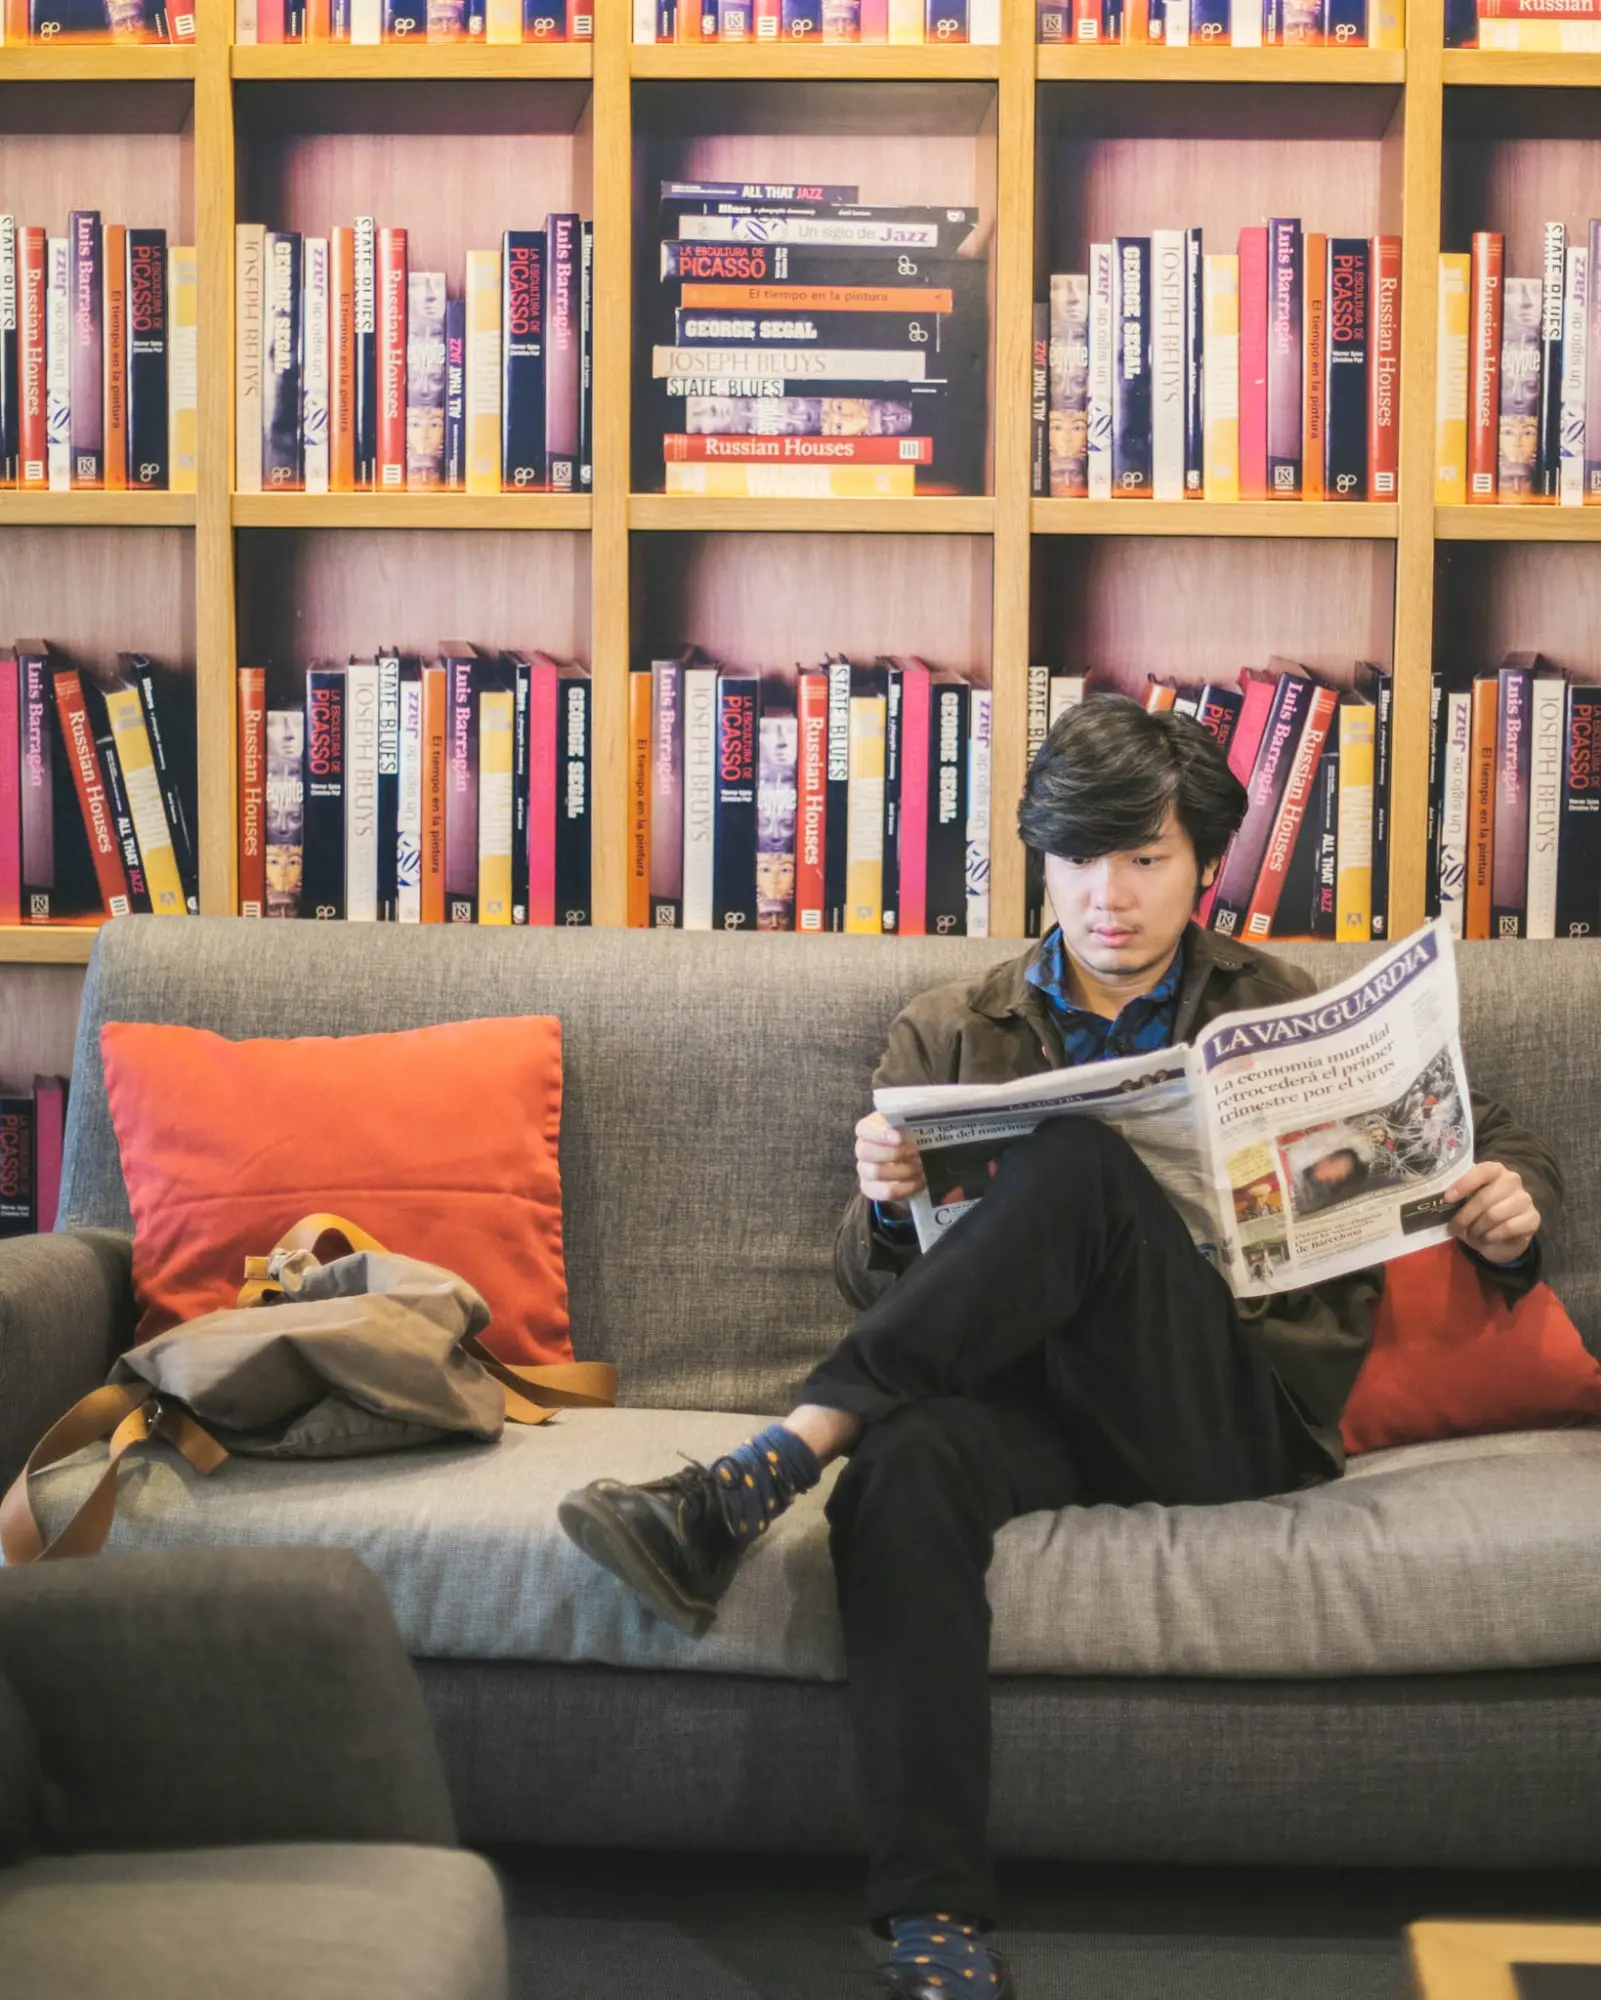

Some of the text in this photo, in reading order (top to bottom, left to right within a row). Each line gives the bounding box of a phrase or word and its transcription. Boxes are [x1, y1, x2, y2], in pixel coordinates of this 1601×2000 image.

[742, 185, 765, 199] ALL
[766, 186, 794, 199] THAT
[796, 187, 823, 200] JAZZ
[78, 217, 94, 256] Luis
[556, 220, 573, 259] Luis
[679, 246, 765, 258] LA ESCULTURA DE
[679, 258, 766, 279] PICASSO
[799, 223, 928, 243] Un siglo de Jazz
[1277, 224, 1294, 264] Luis
[54, 247, 67, 294] Jazz
[131, 246, 152, 332] PICASSO
[312, 248, 325, 297] Jazz
[508, 247, 529, 335] PICASSO
[529, 248, 540, 333] LA DE
[749, 288, 888, 304] El tiempo en la pintura
[1097, 253, 1110, 303] Jazz
[1332, 255, 1354, 342] PICASSO
[1353, 255, 1364, 340] LA DE
[1573, 256, 1586, 330] de Jazz
[26, 268, 43, 416] Russian Houses
[110, 290, 122, 429] El tiempo pintura
[386, 269, 403, 420] Russian Houses
[449, 337, 462, 364] JAZZ
[667, 351, 827, 374] JOSEPH BEUYS
[685, 319, 818, 340] GEORGE SEGAL
[1036, 340, 1048, 367] JAZZ
[1377, 277, 1397, 427] Russian Houses
[449, 366, 462, 393] THAT
[669, 379, 782, 397] STATE BLUES
[1035, 368, 1047, 396] THAT
[1309, 299, 1322, 439] El tiempo en la pintura
[1480, 356, 1497, 427] Houses
[448, 393, 462, 419] ALL
[1034, 397, 1047, 421] ALL
[705, 437, 855, 457] Russian Houses
[28, 661, 43, 698] Luis
[330, 690, 341, 702] LA
[406, 691, 419, 740] Jazz
[456, 664, 471, 702] Luis
[660, 667, 677, 702] Luis
[1507, 676, 1523, 714] Luis
[309, 689, 329, 776] PICASSO
[379, 660, 398, 773] STATE BLUES
[567, 686, 585, 819] GEORGE SEGAL
[720, 696, 742, 782] PICASSO
[828, 667, 849, 781] STATE BLUES
[977, 700, 991, 748] Jazz
[1256, 681, 1304, 806] Luis Barragán
[1569, 704, 1592, 790] PICASSO
[69, 711, 112, 854] Russian Houses
[243, 709, 262, 857] Russian Houses
[330, 761, 341, 774] DE
[354, 683, 374, 837] JOSEPH BEUYS
[689, 688, 711, 843] JOSEPH BEUYS
[804, 717, 825, 866] Russian Houses
[1448, 703, 1468, 835] Un siglo de Jazz
[1534, 697, 1559, 853] JOSEPH BEUYS
[430, 735, 442, 874] El tiempo en la pintura
[635, 739, 647, 877] El en la pintura
[1269, 730, 1325, 872] Russian Houses
[1477, 747, 1492, 887] El tiempo en la pintura
[117, 816, 144, 894] ALL THAT JAZZ
[1320, 856, 1334, 885] THAT
[1322, 834, 1335, 855] ALL
[1320, 887, 1333, 913] JAZZ
[1212, 943, 1431, 1058] LA VANGUARDIA
[1213, 1022, 1391, 1096] La economía mundial
[1216, 1039, 1395, 1112] retrocederá el primer
[1219, 1060, 1396, 1126] trimestre por el virus
[0, 1114, 18, 1197] PICASSO
